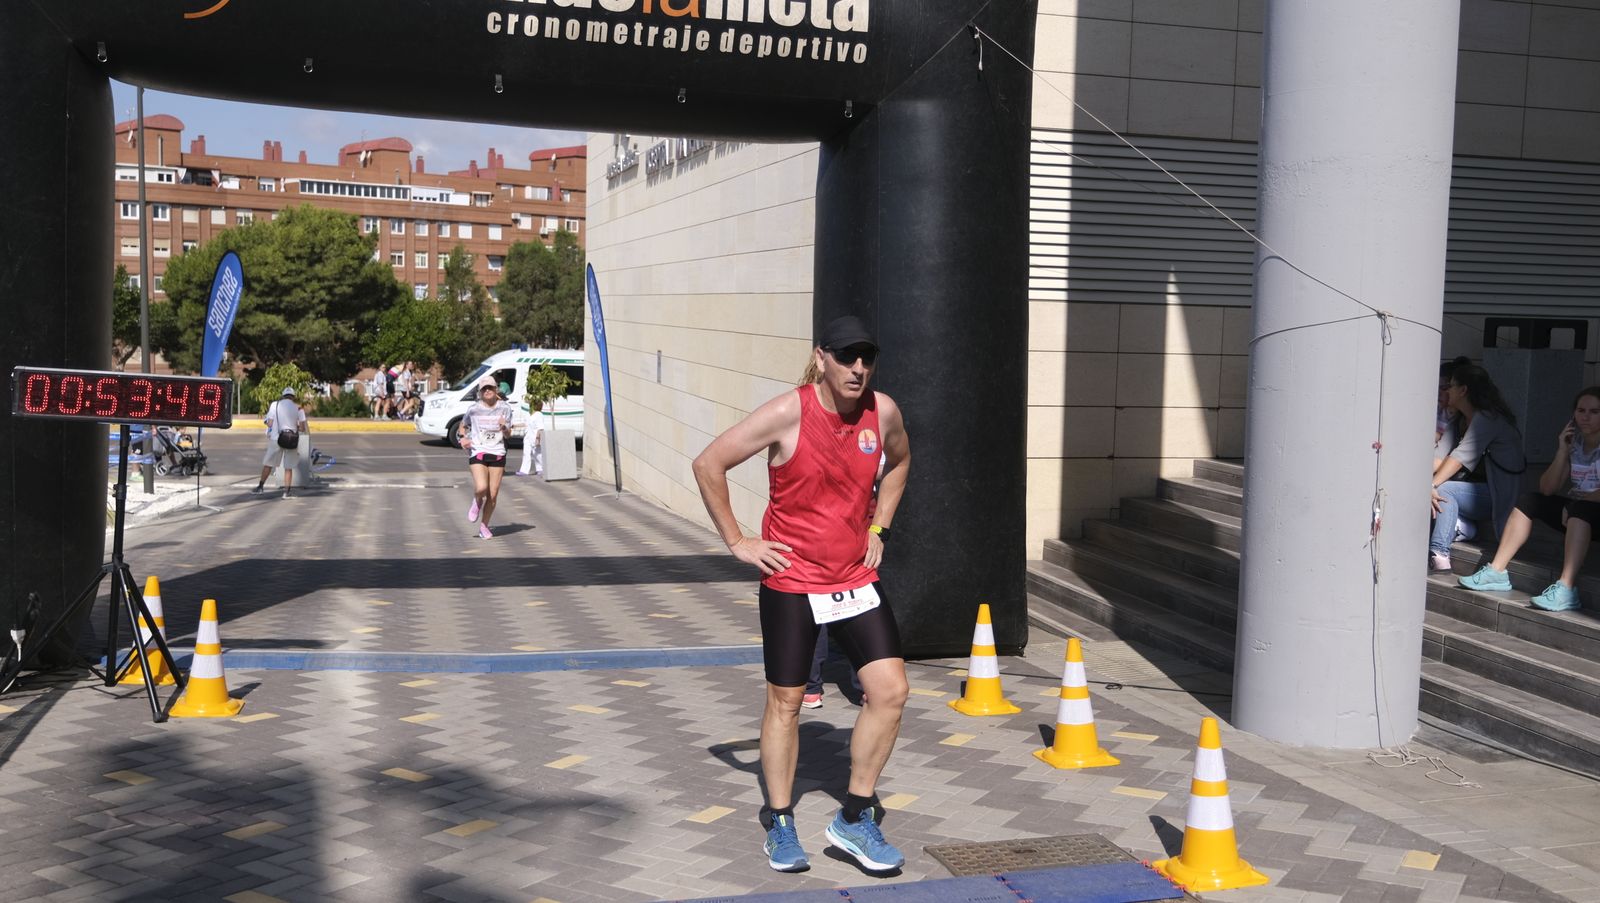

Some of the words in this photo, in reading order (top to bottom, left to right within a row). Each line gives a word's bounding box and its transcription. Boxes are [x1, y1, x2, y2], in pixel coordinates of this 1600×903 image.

[486, 11, 710, 53] cronometraje
[719, 28, 869, 65] deportivo
[24, 373, 222, 422] 00:53:49
[486, 432, 496, 440] 22
